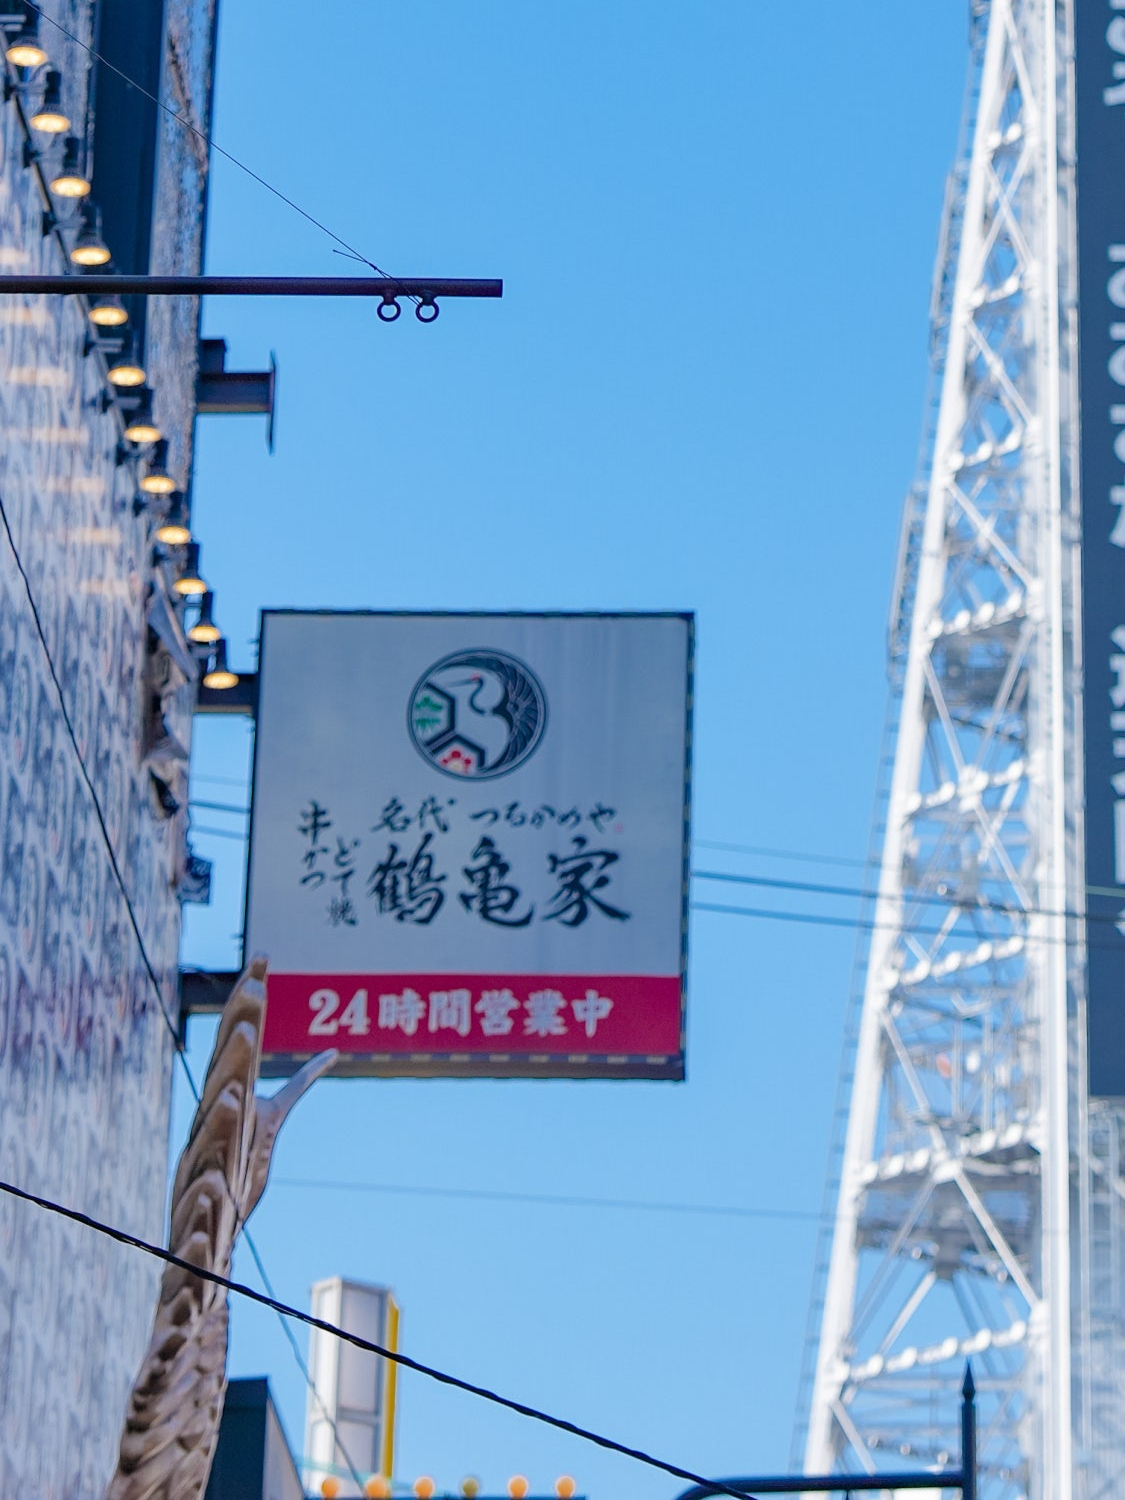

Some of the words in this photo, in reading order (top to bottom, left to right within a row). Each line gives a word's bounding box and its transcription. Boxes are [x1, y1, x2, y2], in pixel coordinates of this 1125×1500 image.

[366, 832, 632, 928] 鶴亀家
[307, 988, 614, 1037] 24時間営業中
